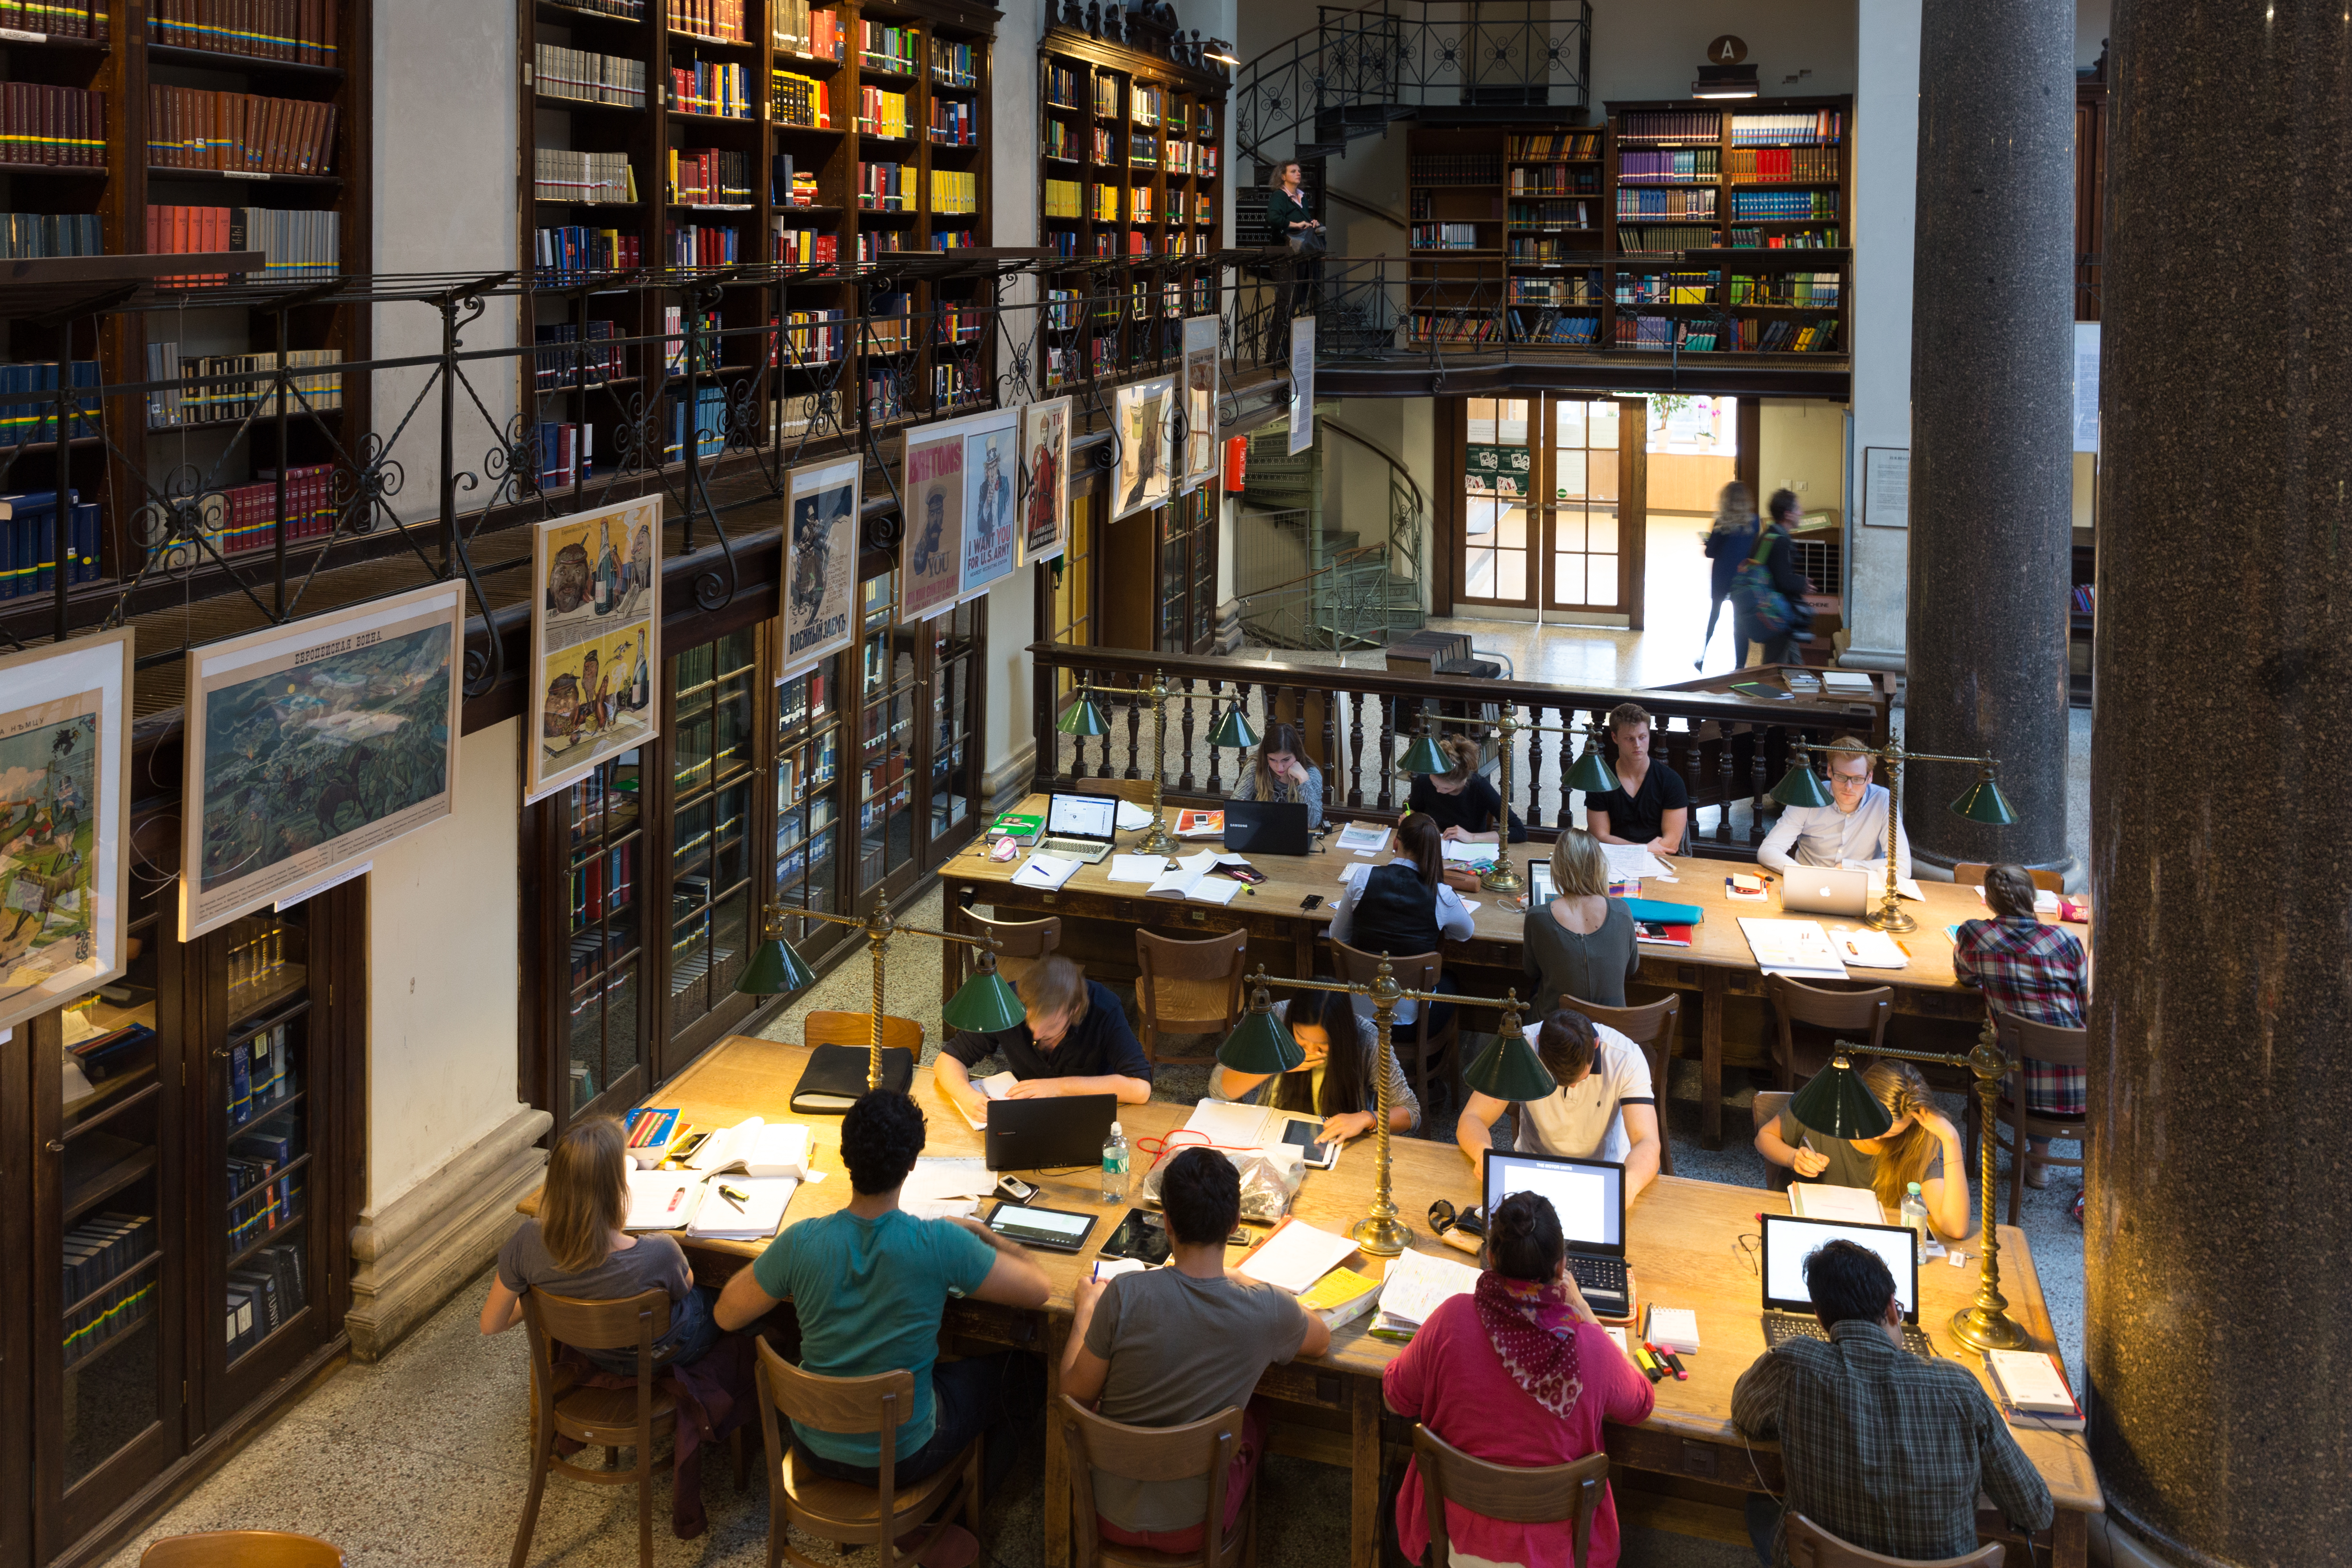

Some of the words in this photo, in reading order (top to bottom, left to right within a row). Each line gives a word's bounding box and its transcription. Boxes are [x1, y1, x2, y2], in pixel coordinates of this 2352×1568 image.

[960, 14, 964, 22] 5
[1721, 40, 1734, 59] A
[908, 442, 961, 485] BRITONS
[968, 541, 971, 557] I
[974, 532, 995, 554] WANT
[996, 524, 1011, 545] YOU
[1029, 530, 1057, 549] ДОБРОВОЛЬЦЕ
[928, 550, 951, 578] YOU
[968, 554, 979, 571] FOR
[980, 550, 993, 565] U.S.
[993, 541, 1010, 560] ARMY
[970, 568, 982, 577] NEAREST
[982, 563, 996, 572] RECRUITING
[997, 558, 1007, 567] STATION
[906, 591, 915, 606] JOIN
[916, 587, 926, 602] YOUR
[926, 579, 945, 598] COUNTRY'S
[945, 574, 958, 591] ARMY!
[922, 599, 931, 608] SAVE
[942, 591, 951, 599] KING
[295, 638, 351, 664] ЕВРОПЕЙСКАЯ
[356, 631, 383, 647] ВОЙНА.
[789, 619, 822, 655] ВОЕННЫЙ
[822, 613, 846, 639] ЗАЕМЪ
[11, 717, 44, 733] НѢМЦУ
